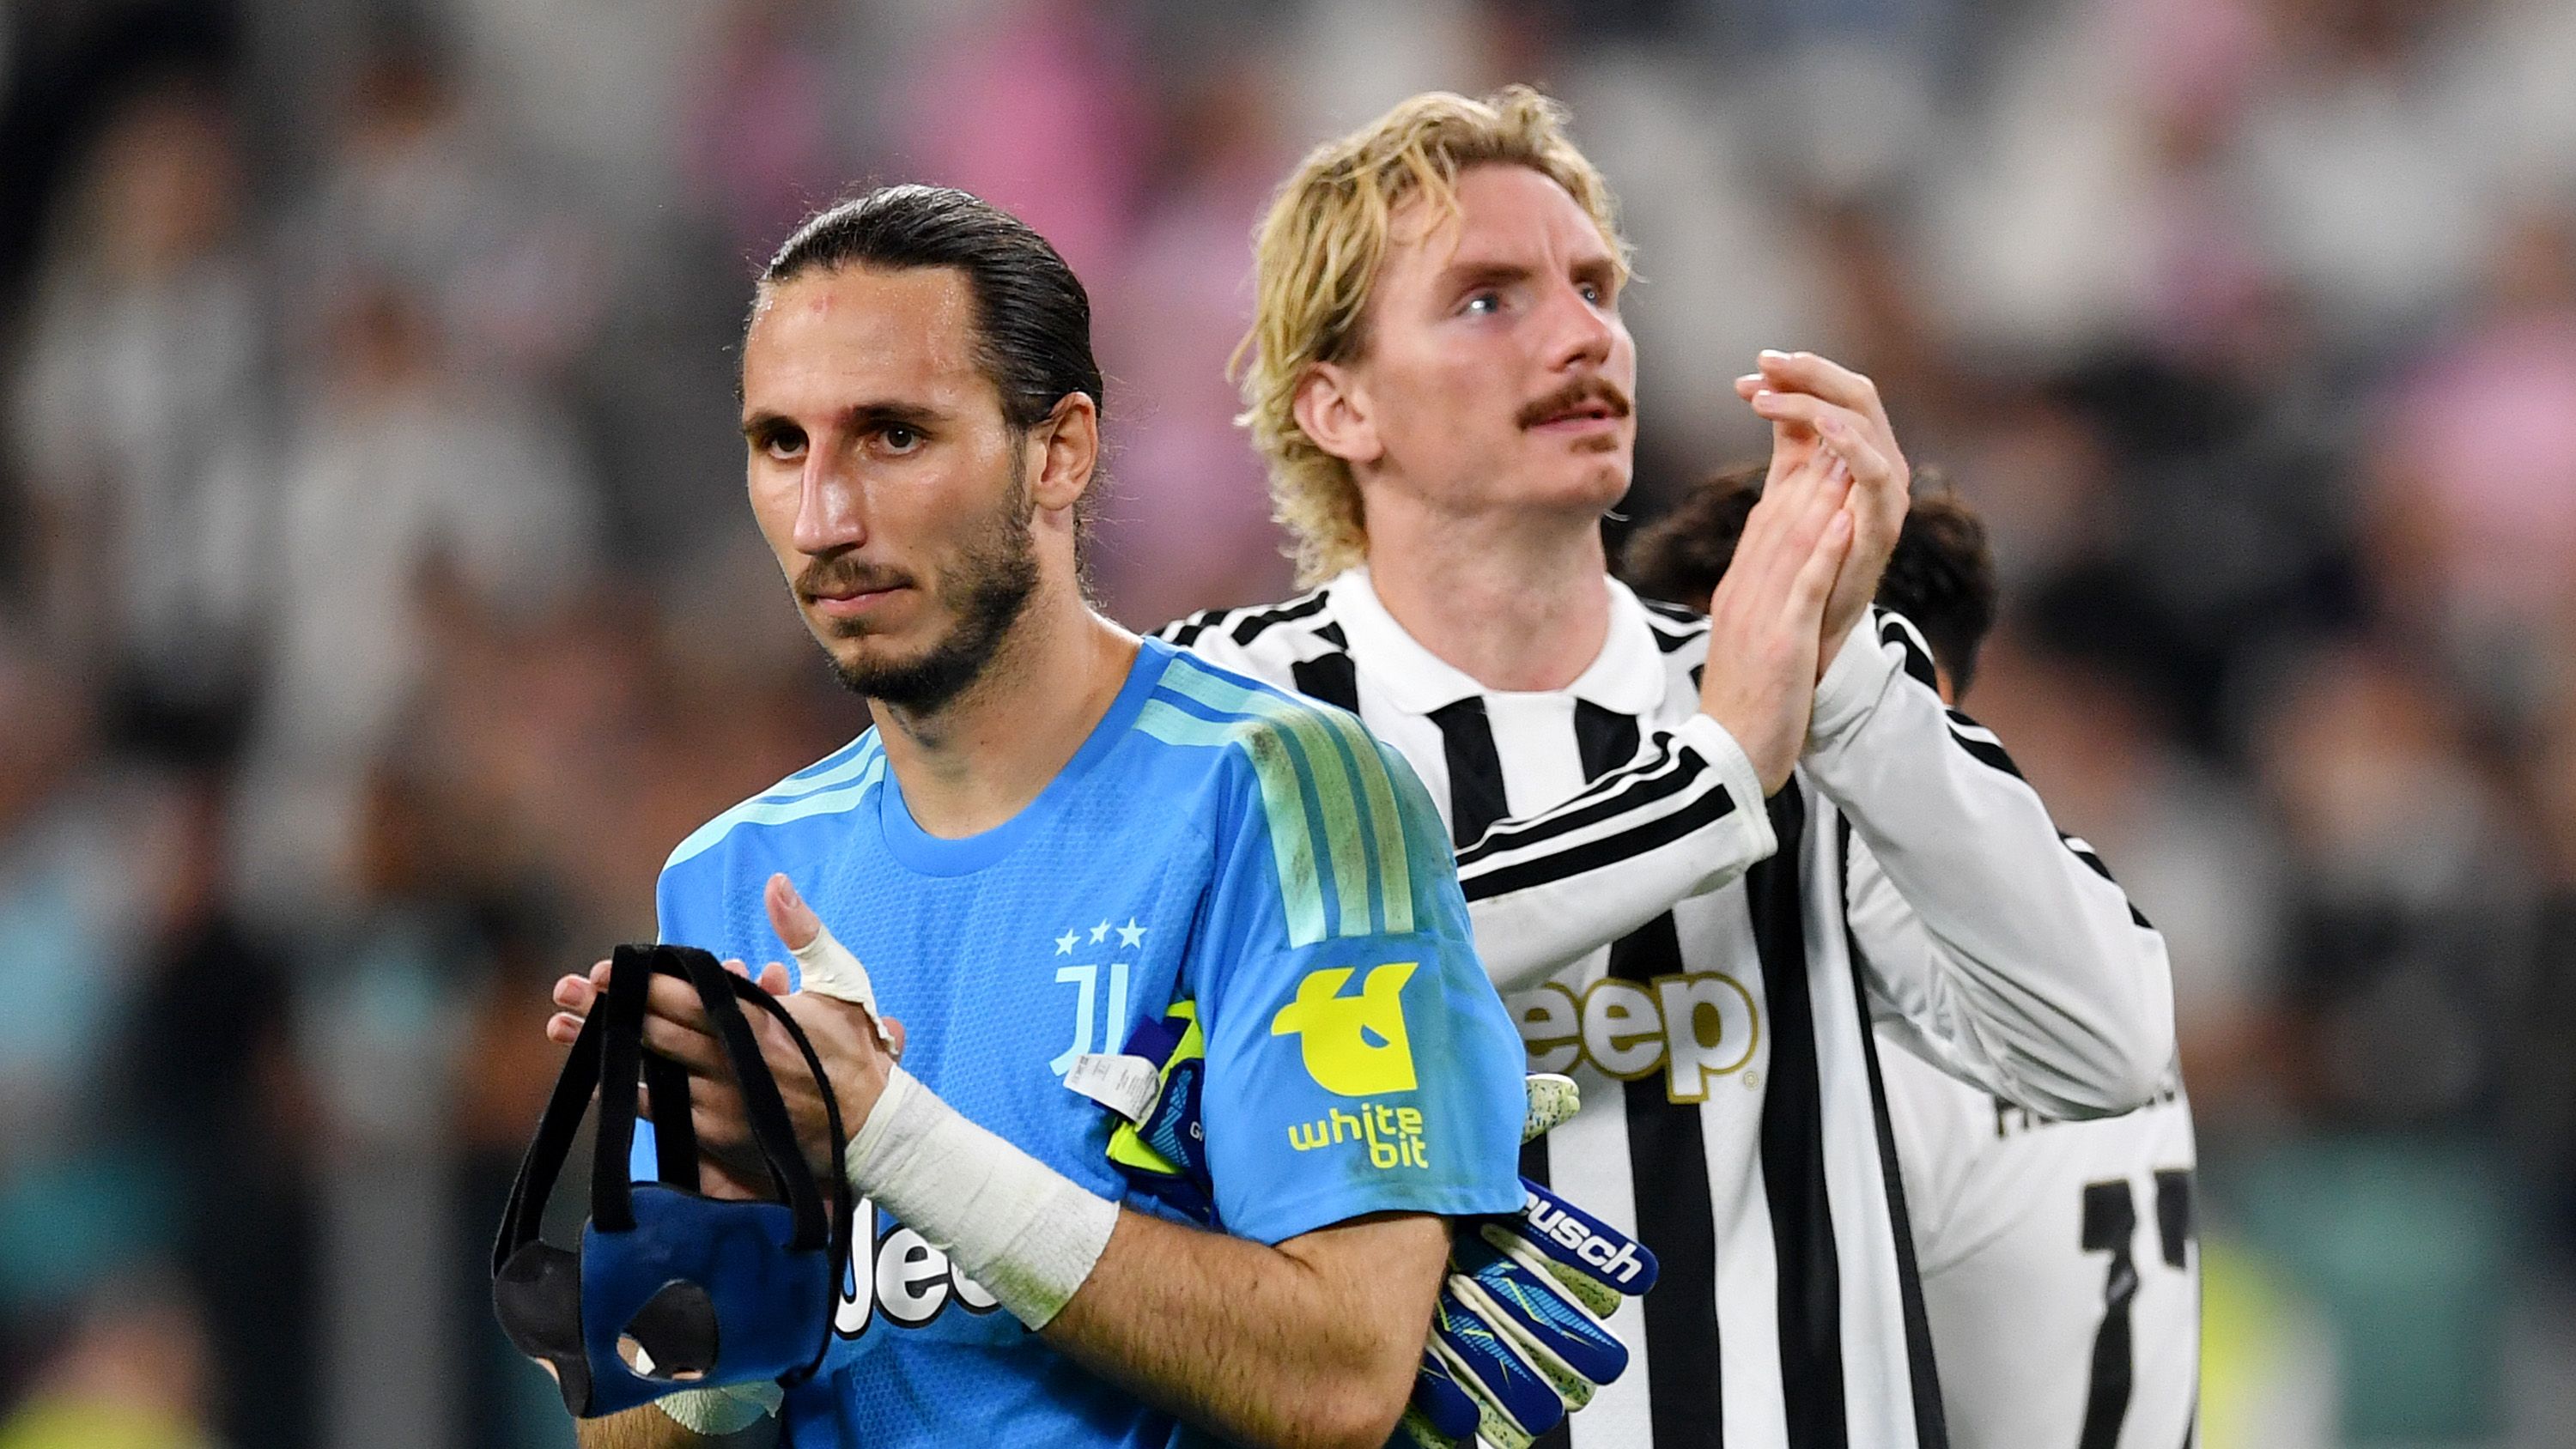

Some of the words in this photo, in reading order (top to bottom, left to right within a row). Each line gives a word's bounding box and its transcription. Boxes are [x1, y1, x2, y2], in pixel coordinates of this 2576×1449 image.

[1288, 1102, 1423, 1151] white
[1369, 1131, 1430, 1169] bit
[832, 1197, 1003, 1340] Je
